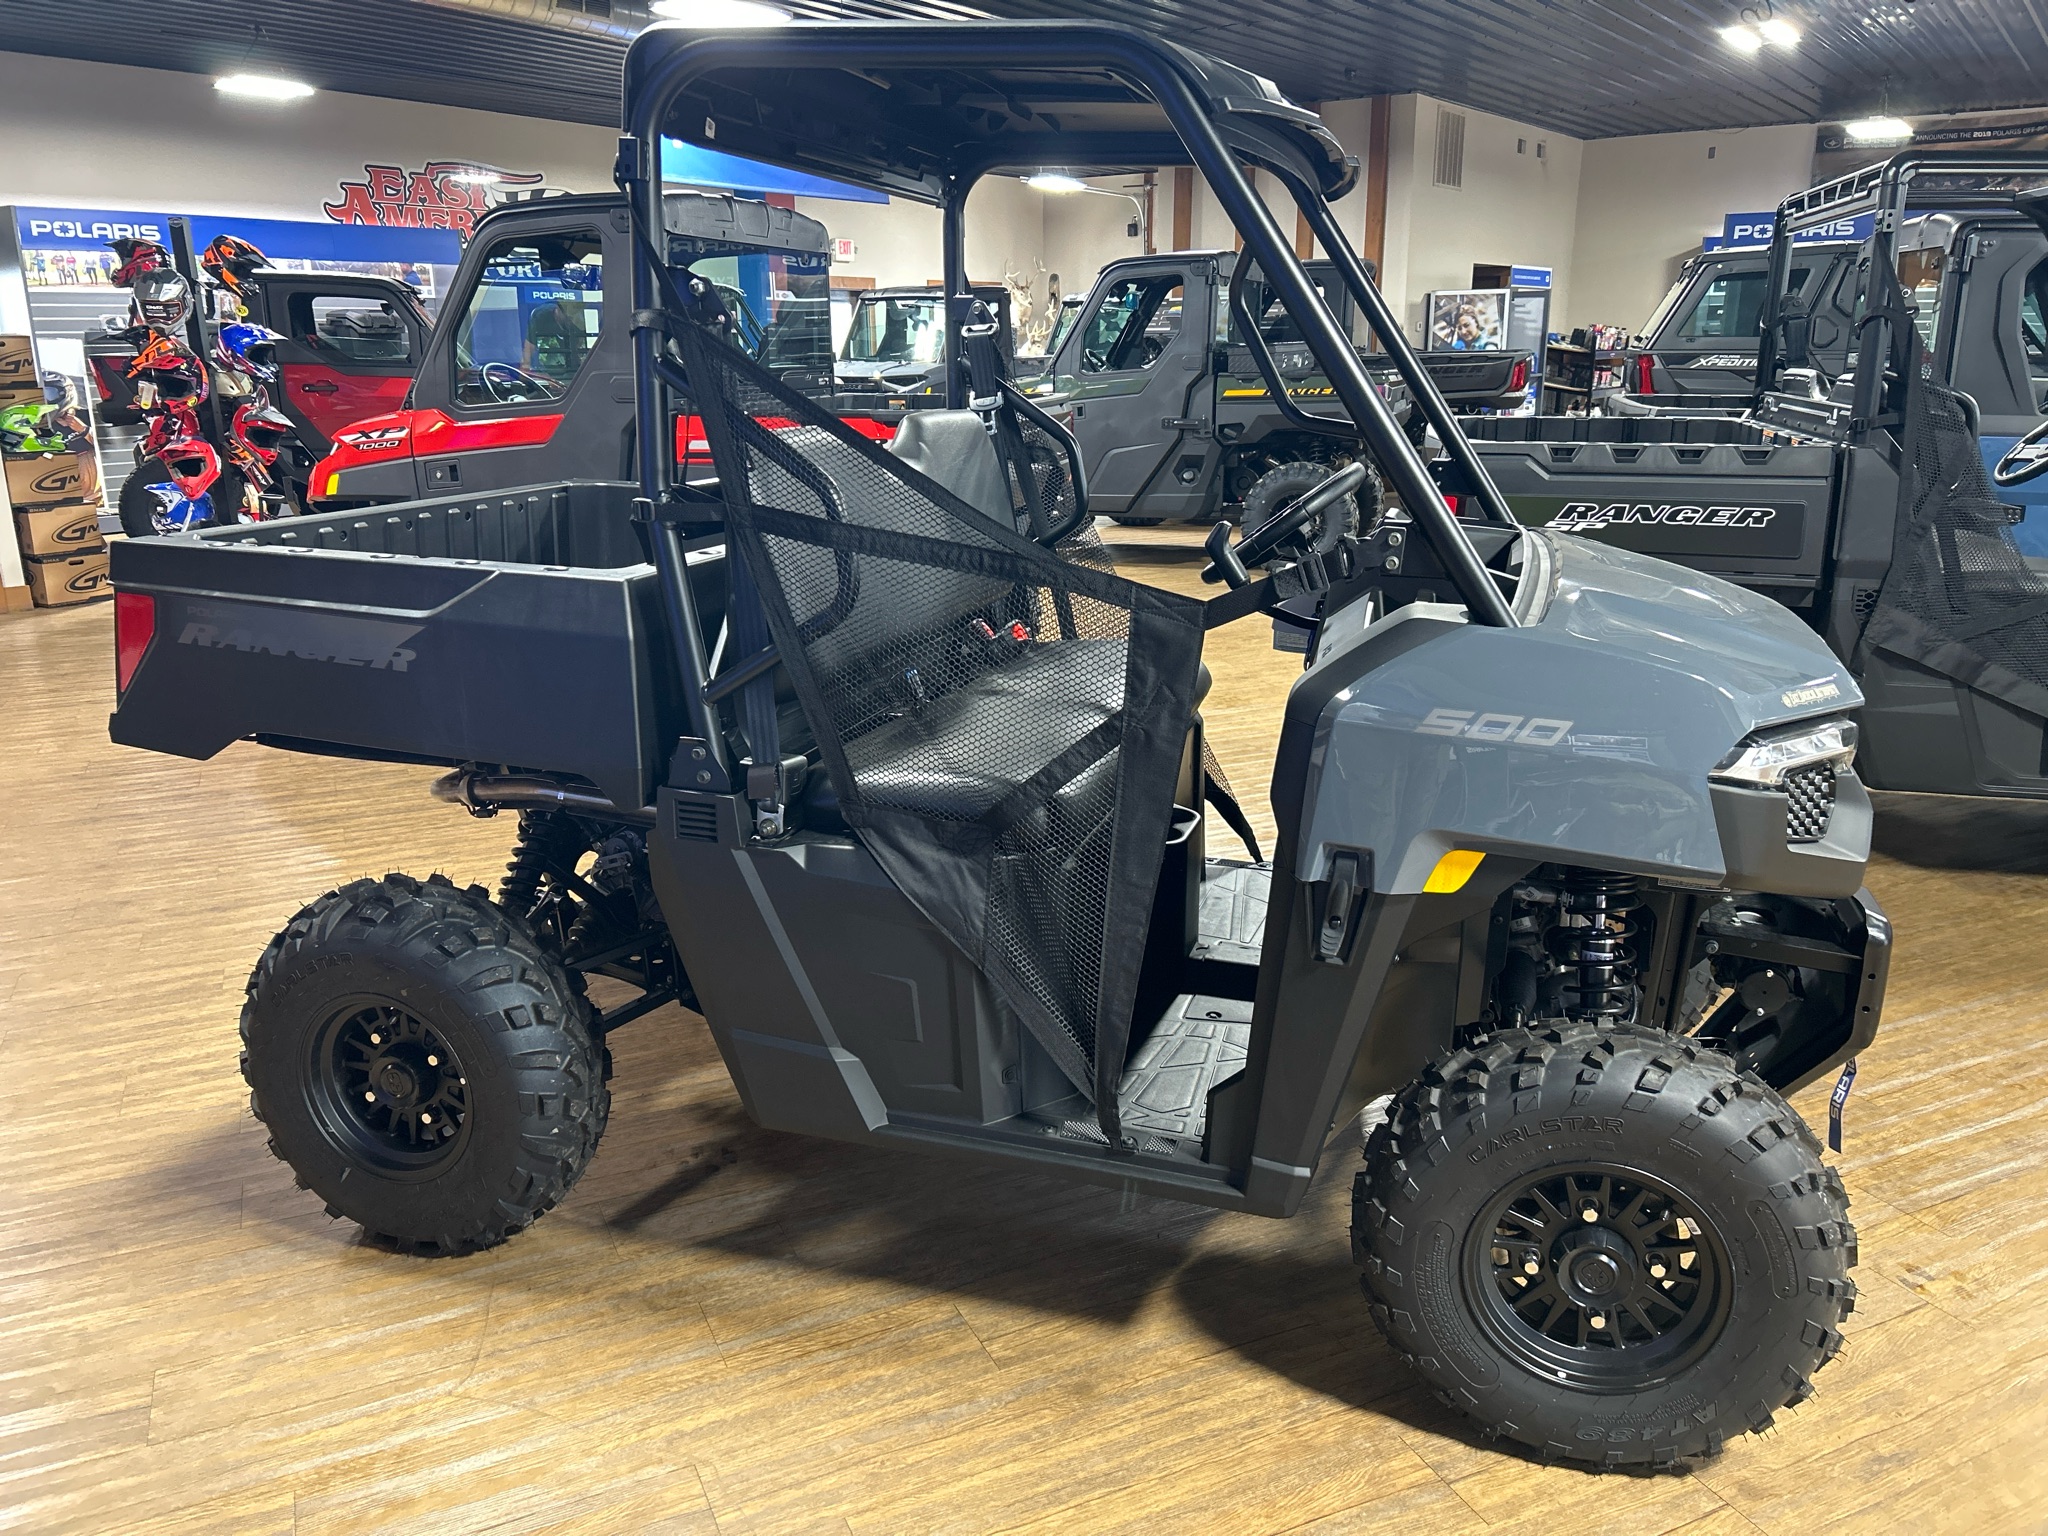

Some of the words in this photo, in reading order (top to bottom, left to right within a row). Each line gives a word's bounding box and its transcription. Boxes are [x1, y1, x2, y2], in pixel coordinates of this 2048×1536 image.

[1959, 131, 1972, 139] THE
[29, 219, 162, 242] POLARIS
[838, 240, 852, 256] EXIT
[532, 291, 576, 300] POLARIS
[349, 426, 407, 442] XP
[358, 439, 399, 450] 1000
[1553, 502, 1776, 528] RANGER
[177, 622, 417, 672] RANGER
[1414, 708, 1574, 746] 500
[1466, 1115, 1625, 1165] CARLSTAR
